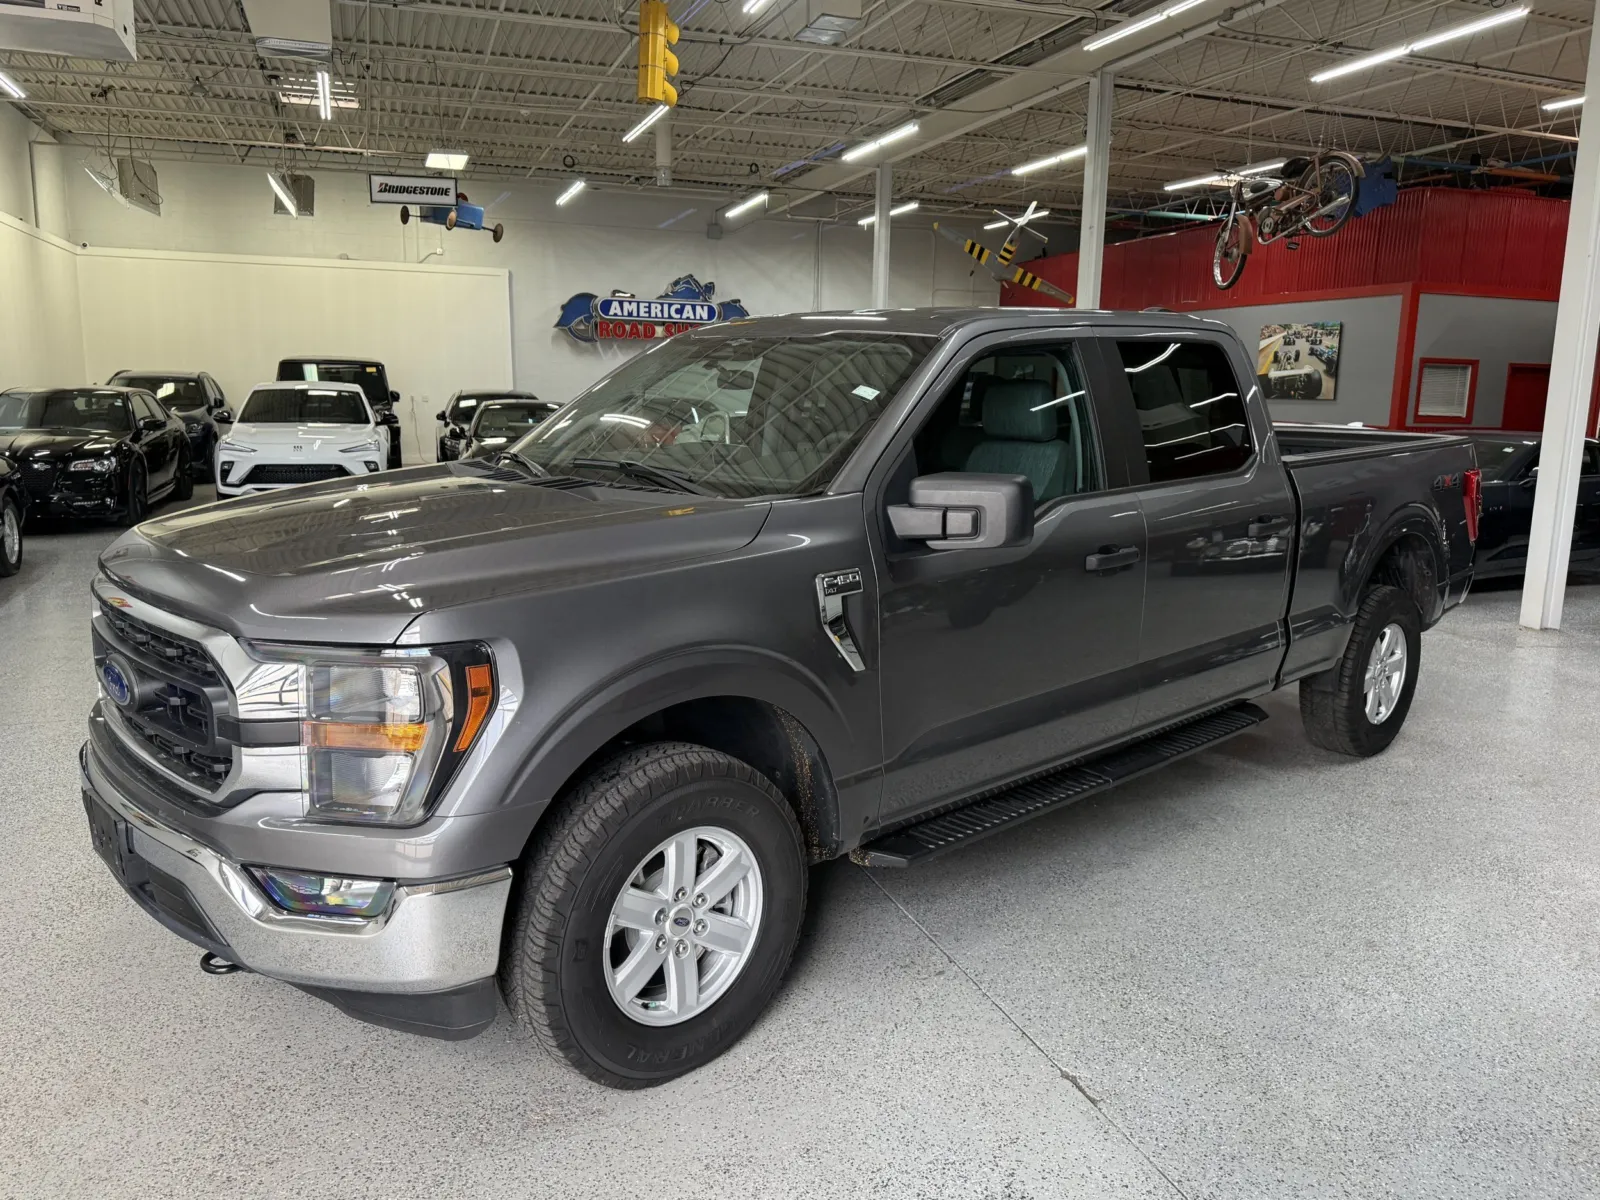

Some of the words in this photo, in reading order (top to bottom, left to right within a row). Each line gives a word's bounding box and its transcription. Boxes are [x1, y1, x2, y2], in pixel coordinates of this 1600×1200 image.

[377, 182, 451, 197] BRIDGESTONE
[609, 301, 709, 320] AMERICAN
[598, 321, 656, 339] ROAD
[664, 323, 701, 339] SH
[824, 573, 859, 587] F-150
